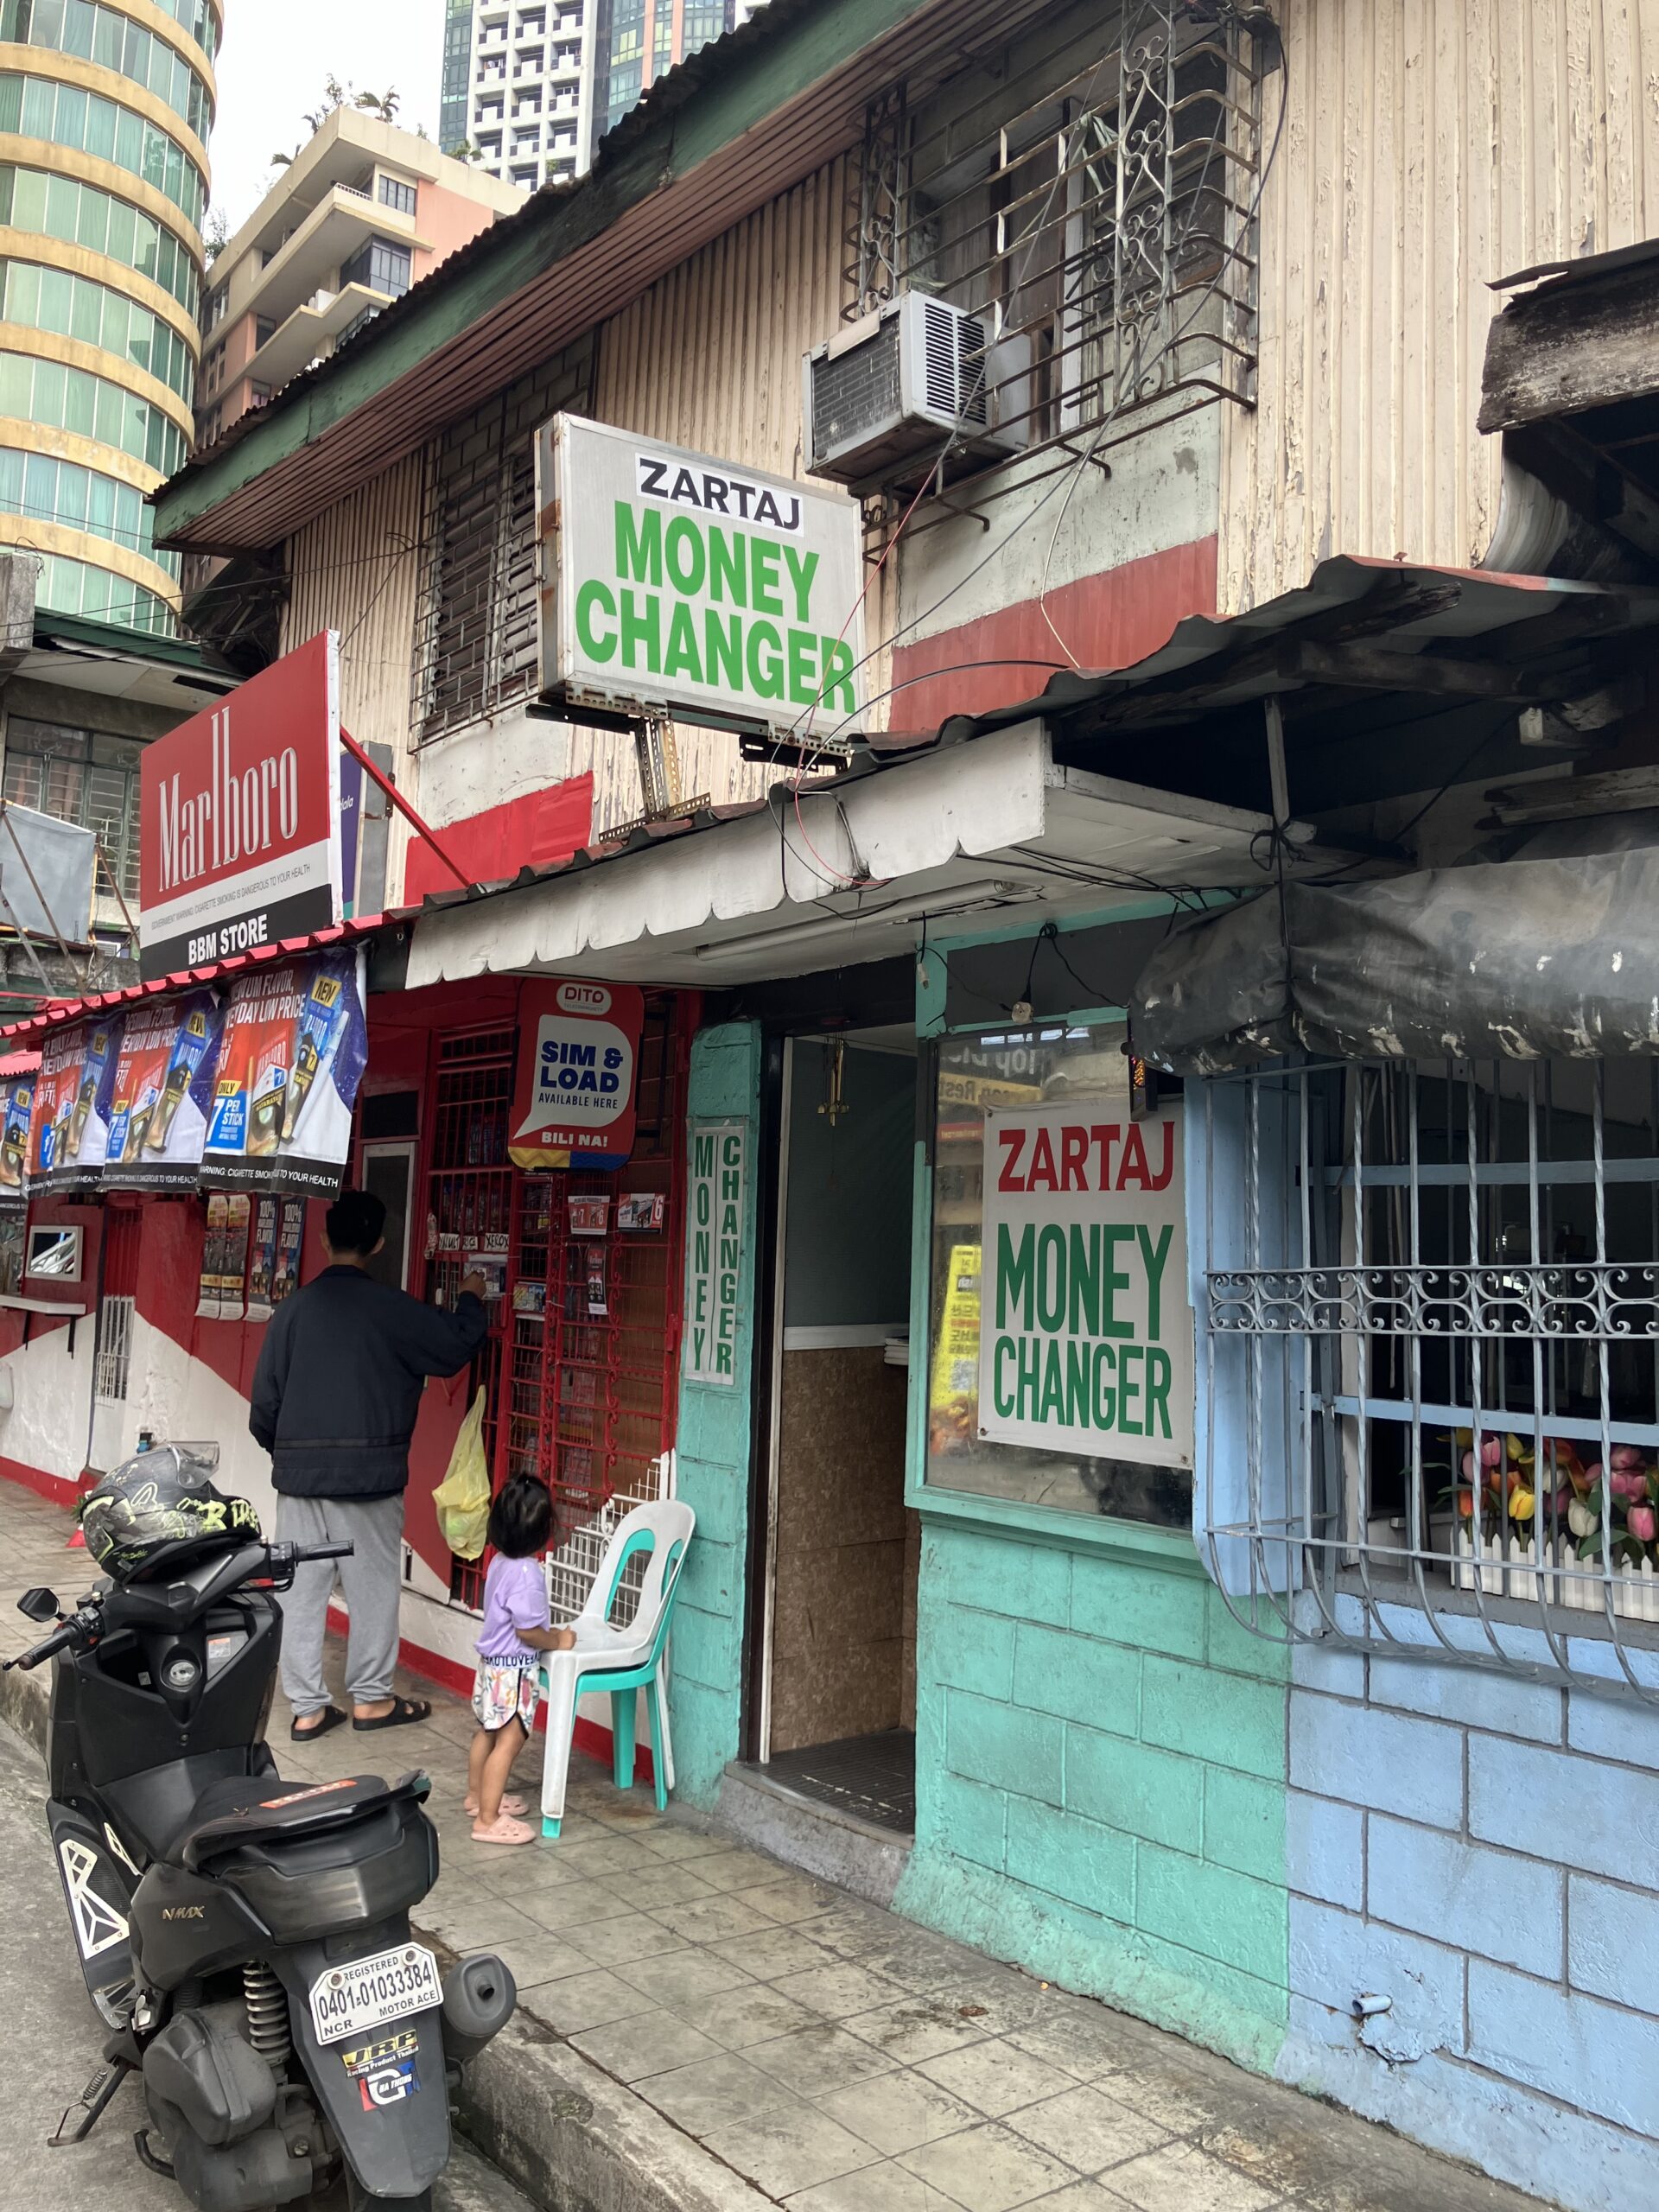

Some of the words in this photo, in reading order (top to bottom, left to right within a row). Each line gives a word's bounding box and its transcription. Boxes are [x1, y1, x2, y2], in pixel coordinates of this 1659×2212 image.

[639, 458, 800, 531] ZARTAJ
[614, 499, 819, 623] MONEY
[575, 579, 855, 715] CHANGER
[159, 706, 297, 892] Marlboro
[194, 898, 216, 914] CIGARETTE
[217, 893, 236, 906] SMOKING
[242, 880, 270, 897] DANGEROUS
[270, 874, 276, 887] TO
[277, 870, 291, 885] YOUR
[291, 863, 310, 879] HEALTH
[188, 932, 216, 965] BBM
[220, 913, 267, 955] STORE
[315, 980, 337, 1003] NEW
[564, 986, 604, 1004] DITO
[259, 997, 279, 1022] LOW
[277, 994, 306, 1020] PRICE
[541, 1040, 596, 1067] SIM
[603, 1047, 624, 1069] &
[219, 1082, 236, 1094] ONLY
[540, 1066, 620, 1093] LOAD
[538, 1093, 589, 1106] AVAILABLE
[593, 1097, 618, 1109] HERE
[207, 1098, 226, 1141] 7
[226, 1099, 241, 1113] PER
[222, 1112, 245, 1126] STICK
[542, 1132, 574, 1145] BILI
[578, 1134, 608, 1147] NA!
[998, 1122, 1175, 1192] ZARTAJ
[165, 1174, 177, 1183] YOUR
[289, 1170, 308, 1183] YOUR
[309, 1174, 339, 1188] HEALTH
[260, 1200, 276, 1218] 100%
[284, 1204, 302, 1223] 100%
[694, 1135, 714, 1370] MONEY
[715, 1135, 741, 1374] CHANGER
[995, 1224, 1174, 1341] MONEY
[994, 1335, 1173, 1439] CHANGER
[162, 1905, 205, 1921] NMAX
[344, 1956, 398, 1981] REGISTERED
[379, 1997, 414, 2018] MOTOR
[417, 1990, 436, 2004] ACE
[324, 2019, 353, 2037] NCR
[346, 2031, 415, 2066] JRP
[370, 2056, 396, 2069] Product
